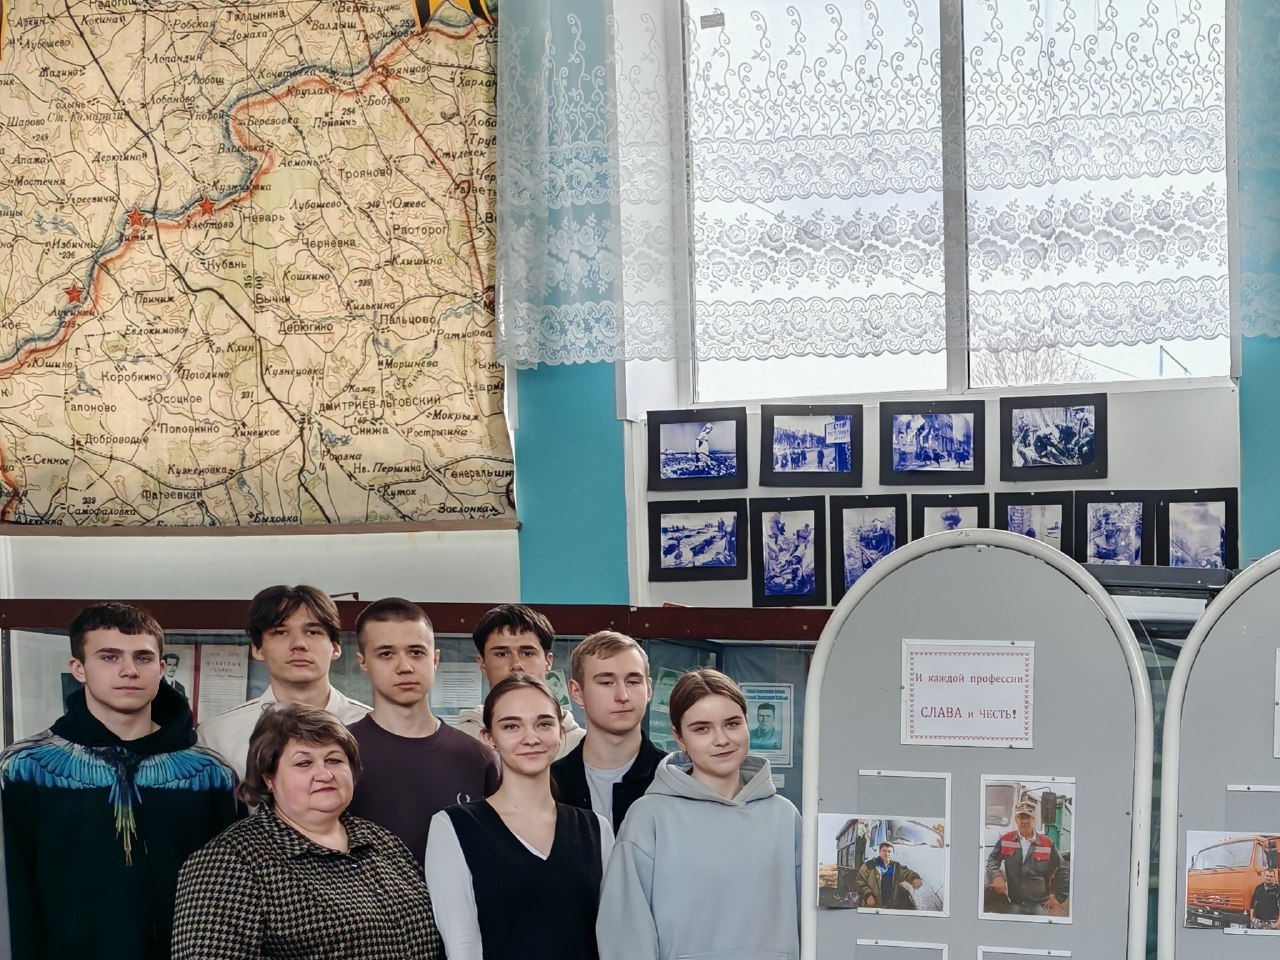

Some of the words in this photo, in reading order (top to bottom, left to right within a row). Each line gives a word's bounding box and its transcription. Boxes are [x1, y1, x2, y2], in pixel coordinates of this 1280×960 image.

[243, 214, 284, 223] Неварь
[207, 261, 246, 271] Кубань
[283, 271, 330, 281] Кошкино
[256, 294, 290, 304] Бычки
[379, 315, 436, 325] Пальцово
[278, 324, 333, 333] Дерюгино
[101, 371, 163, 383] Коробкино
[154, 394, 202, 405] Осоцкое
[160, 423, 220, 434] Поповкино
[915, 673, 922, 682] И
[928, 674, 964, 683] каждой
[969, 674, 1024, 685] профессии
[920, 707, 962, 718] СЛАВА
[968, 711, 974, 719] и
[979, 709, 1017, 720] ЧЕСТЬ!
